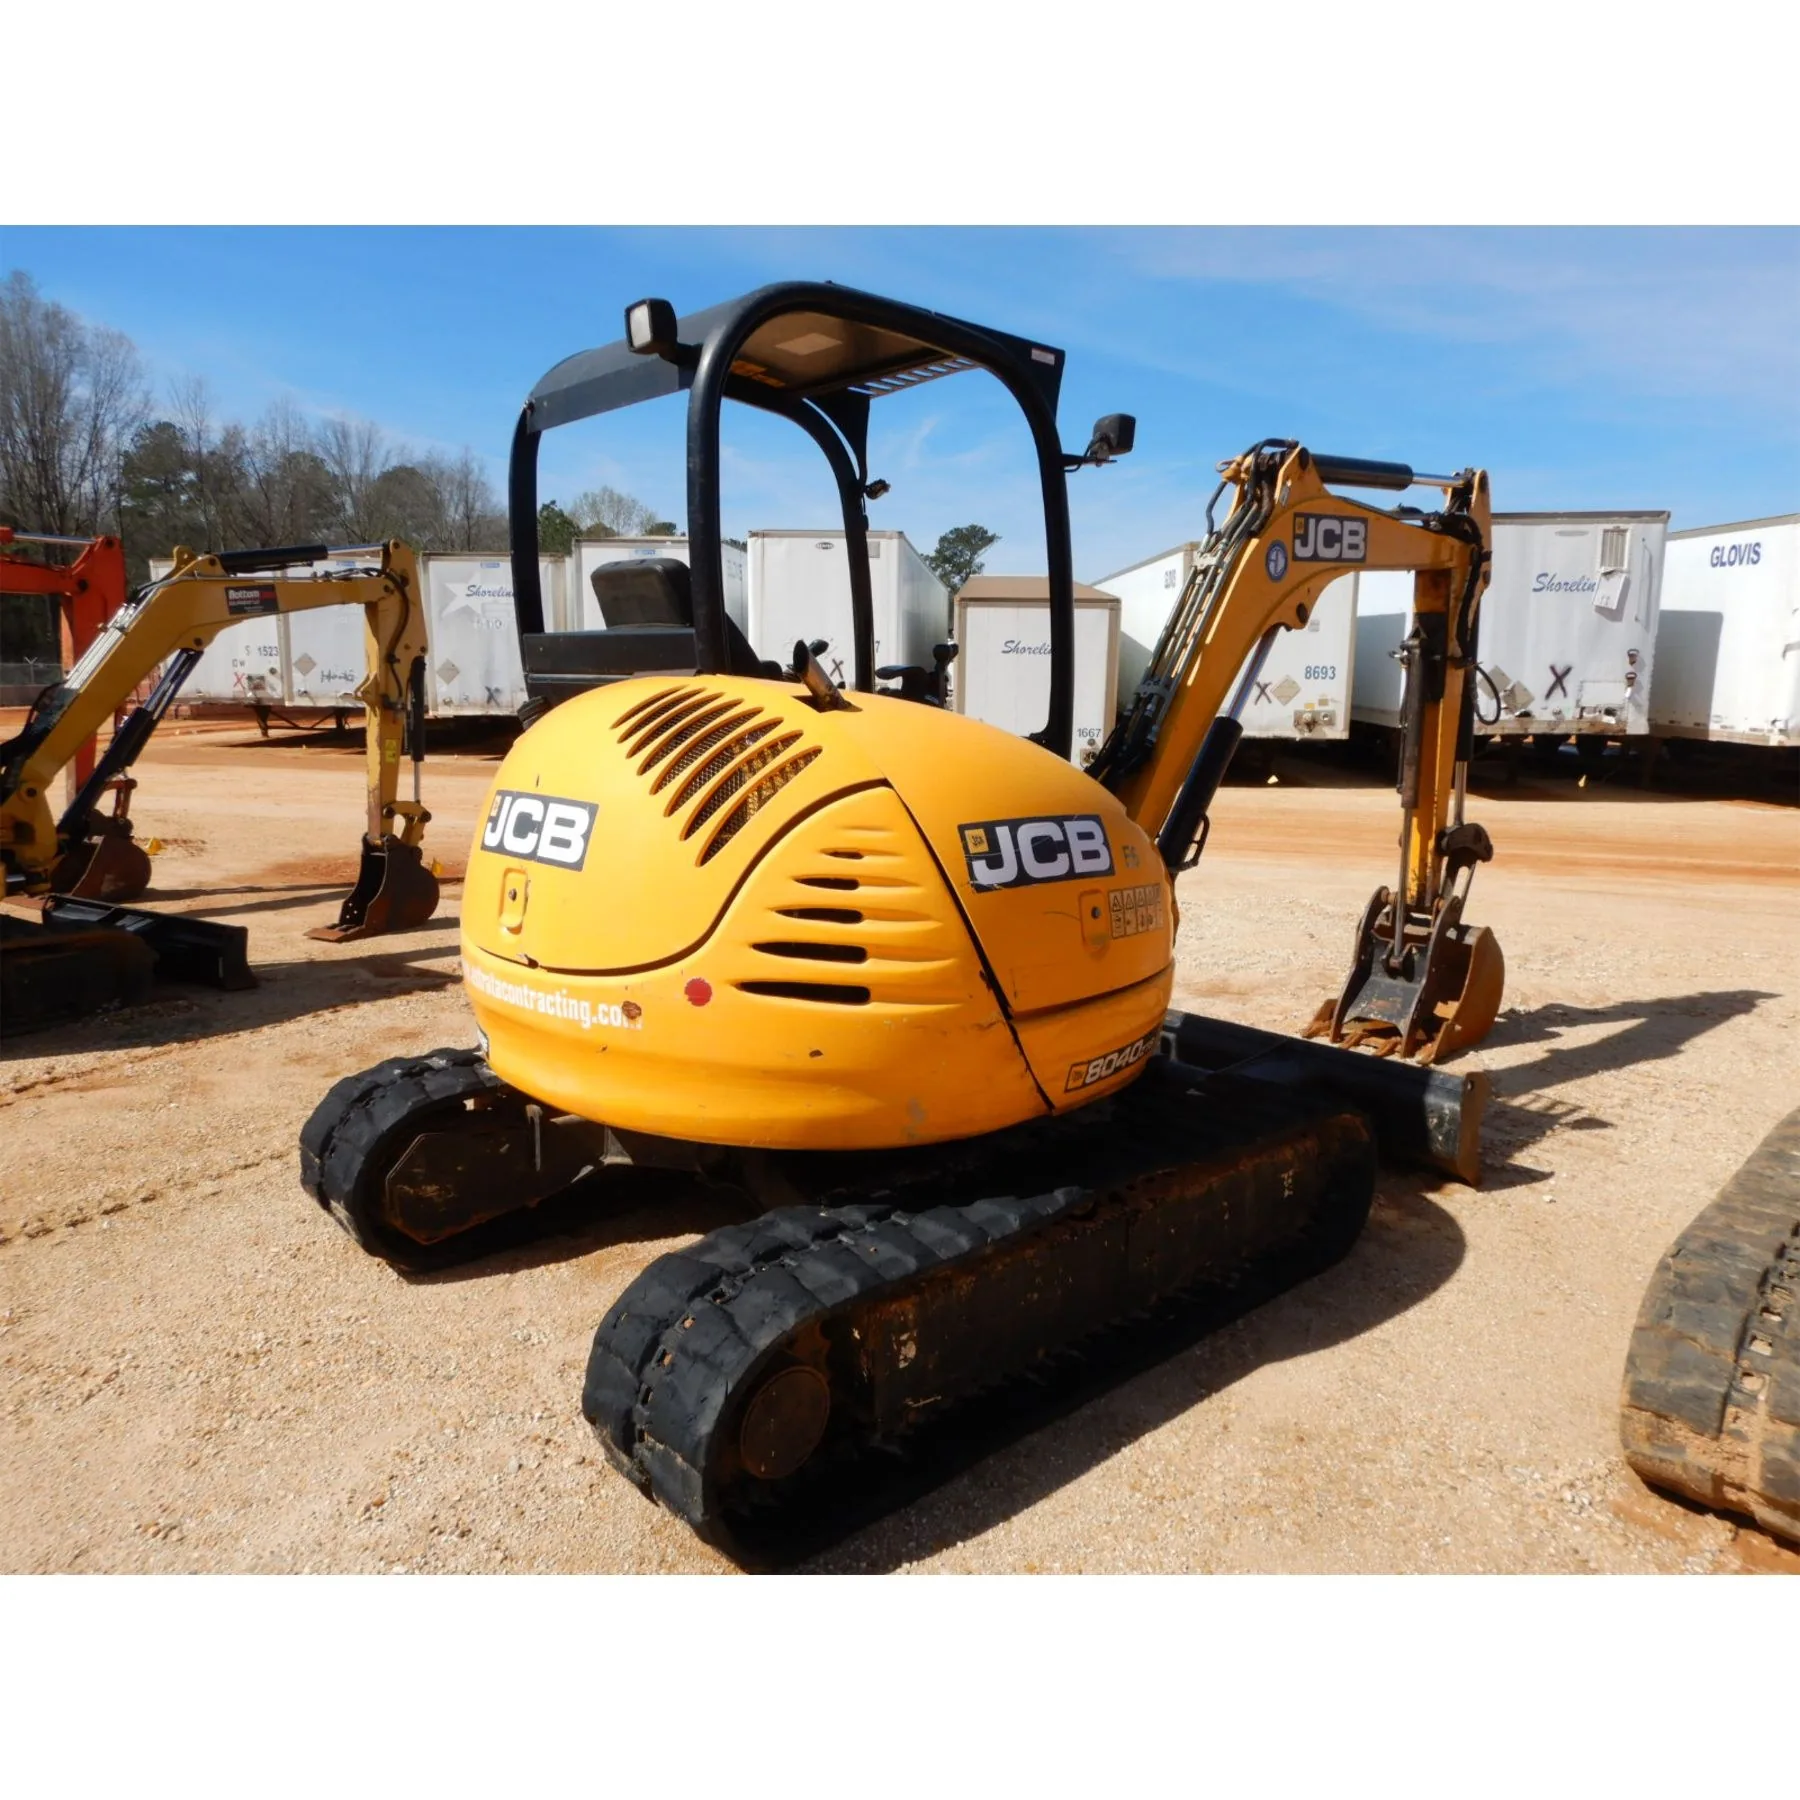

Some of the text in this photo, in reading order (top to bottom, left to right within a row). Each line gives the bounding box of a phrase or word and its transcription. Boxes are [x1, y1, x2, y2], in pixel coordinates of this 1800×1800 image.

[1294, 518, 1366, 559] JCB
[1710, 541, 1762, 568] GLOVIS
[1532, 572, 1597, 592] Shorelin
[1001, 640, 1051, 655] Shoreli
[1304, 665, 1336, 680] 8693
[1077, 727, 1101, 738] 1667
[483, 795, 590, 864] JCB
[971, 819, 1111, 885] JCB
